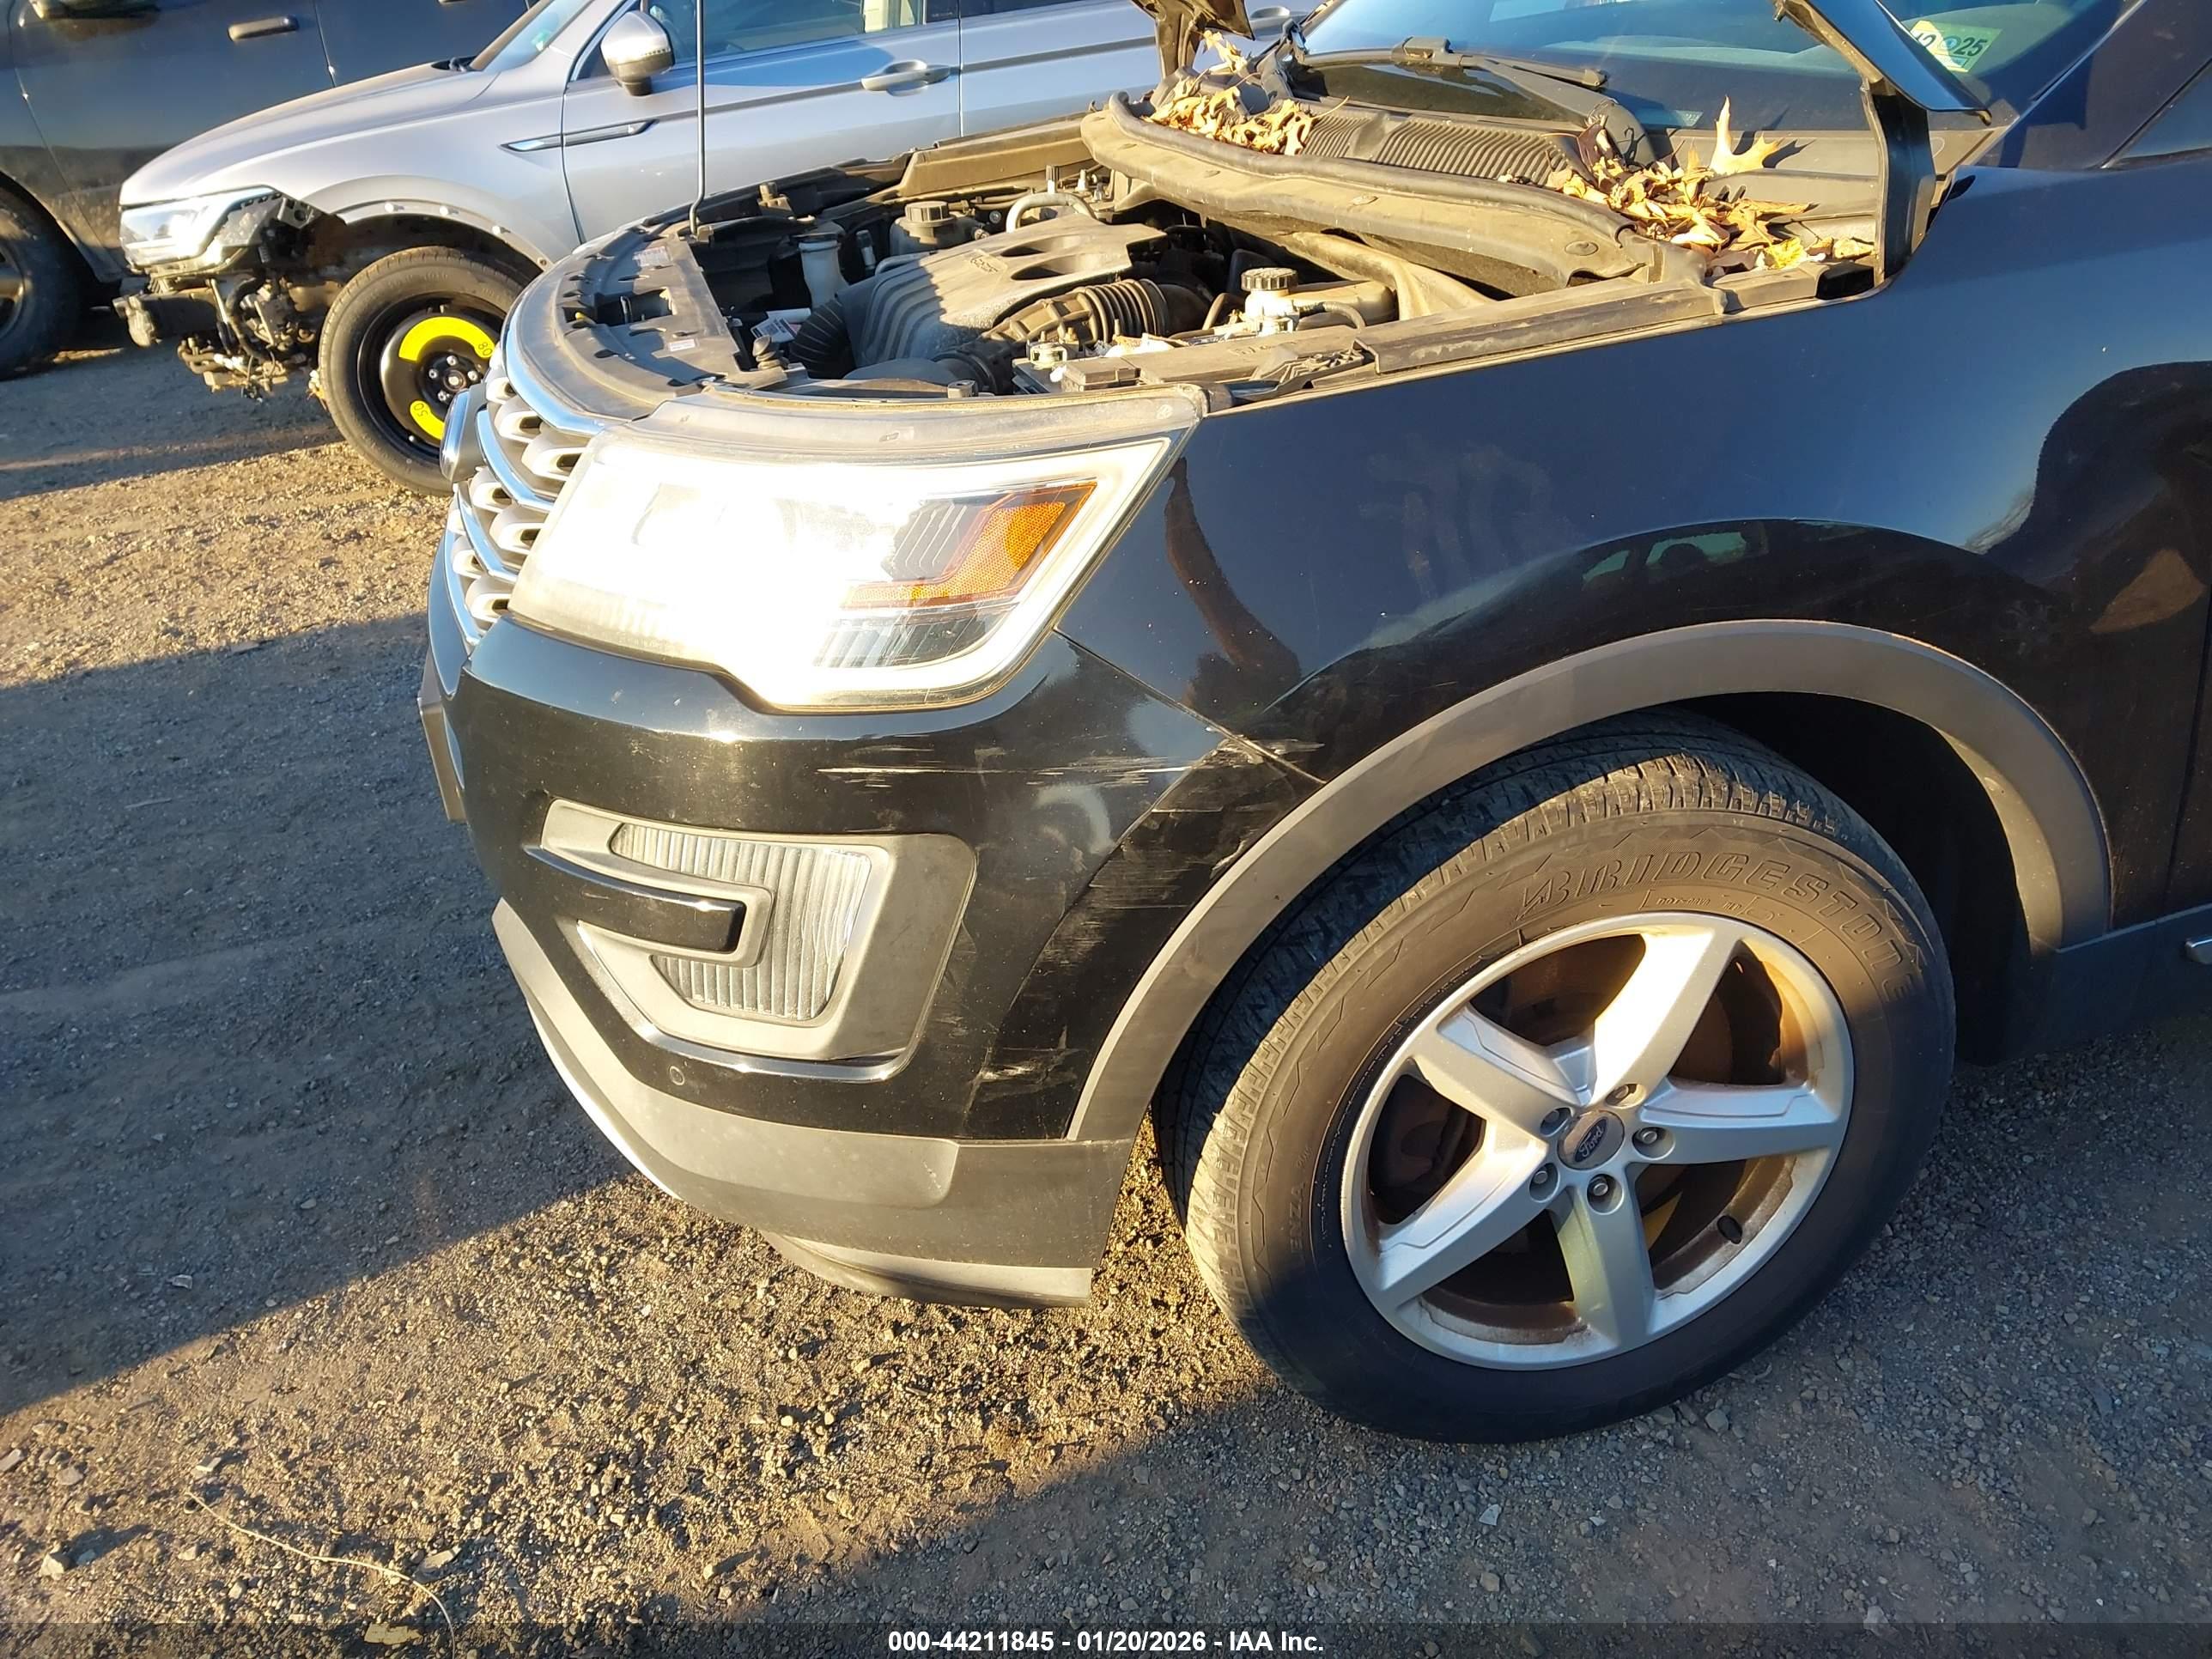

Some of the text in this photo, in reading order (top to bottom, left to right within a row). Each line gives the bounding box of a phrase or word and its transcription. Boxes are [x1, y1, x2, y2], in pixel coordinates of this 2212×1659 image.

[1953, 36, 1988, 57] 25
[478, 342, 493, 356] 80
[1516, 849, 1917, 1005] BRIDGESTONE
[1578, 1123, 1605, 1159] Ford
